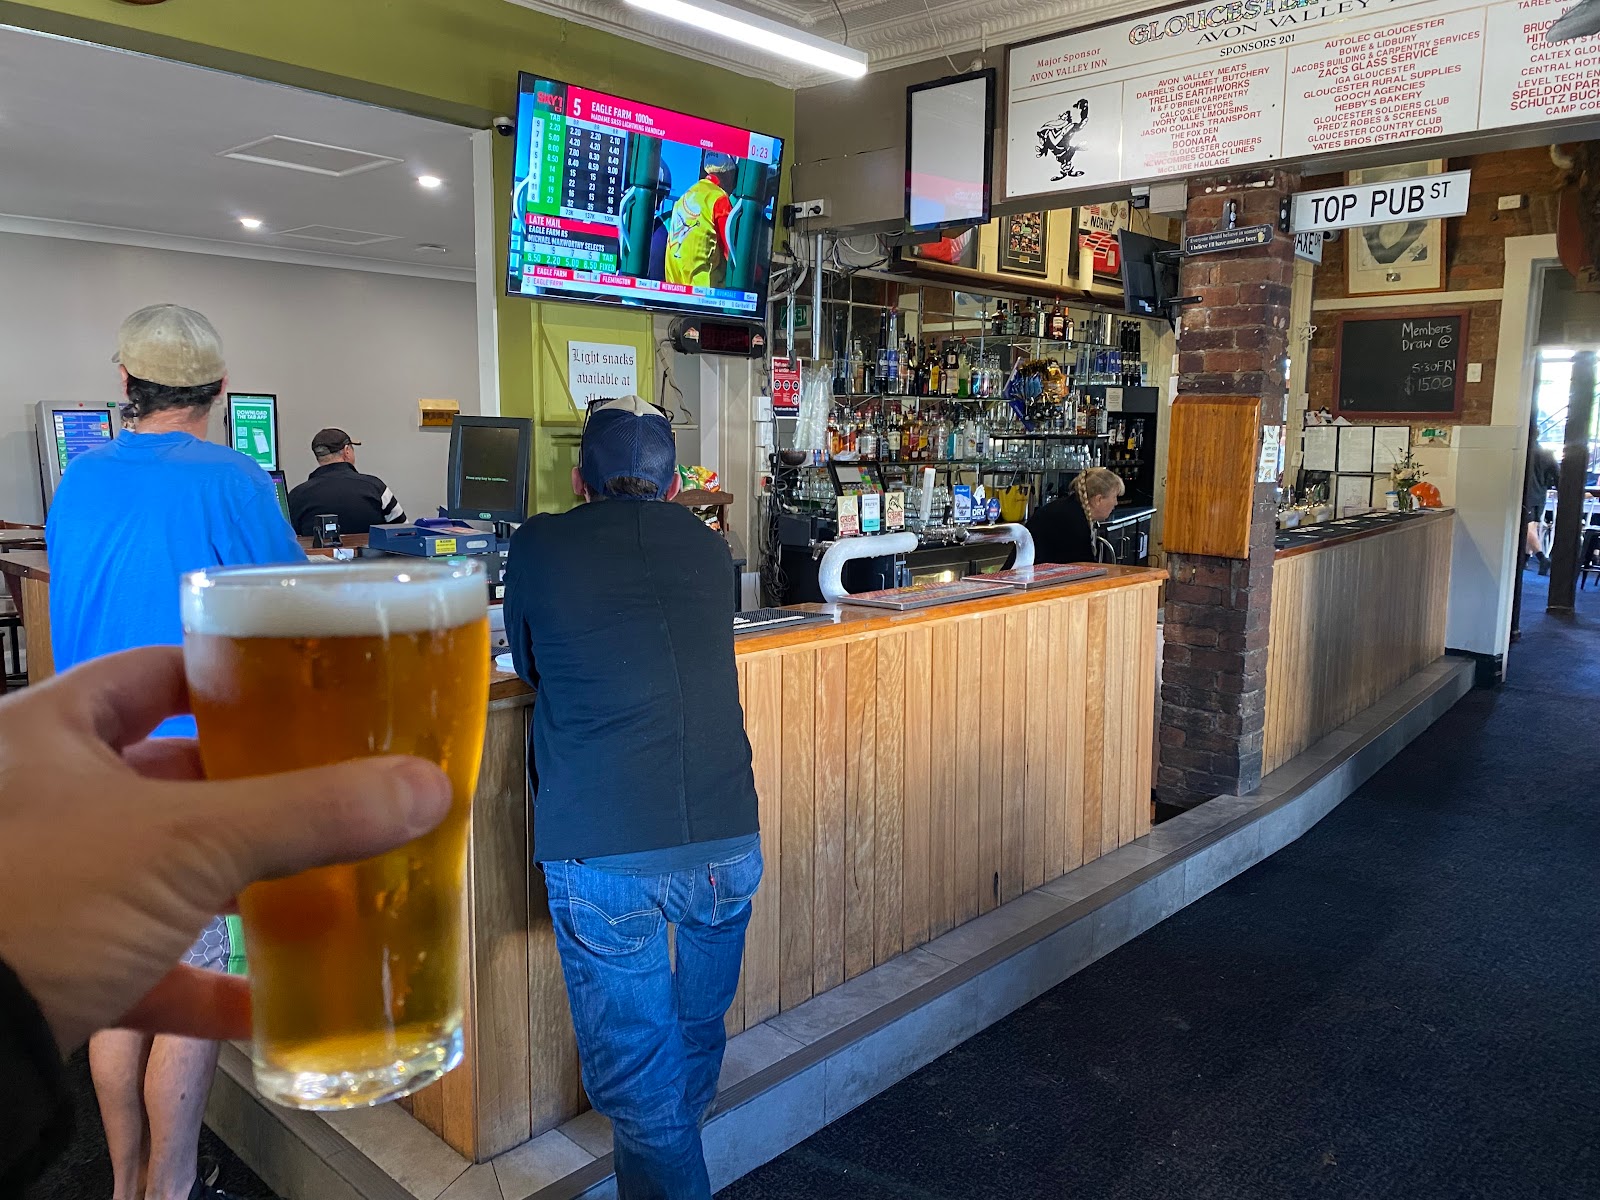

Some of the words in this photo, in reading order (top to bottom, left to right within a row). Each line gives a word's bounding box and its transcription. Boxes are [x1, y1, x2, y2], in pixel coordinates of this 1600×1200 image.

[1196, 21, 1258, 45] AVON
[1268, 0, 1370, 28] VALLEY
[1324, 33, 1370, 49] AUTOLEC
[1373, 18, 1445, 38] GLOUCESTER
[1220, 40, 1276, 57] SPONSORS
[1279, 34, 1295, 44] 201
[1291, 61, 1325, 74] JACOBS
[1327, 53, 1366, 67] BUILDING
[1376, 40, 1431, 57] CARPENTRY
[1433, 30, 1480, 46] SERVICES
[1339, 44, 1366, 56] BOWE
[1377, 34, 1418, 48] LIDBURY
[1037, 55, 1061, 68] Major
[1063, 48, 1101, 62] Sponsor
[1318, 65, 1348, 78] ZAC'S
[1351, 56, 1388, 72] GLASS
[1391, 46, 1439, 64] SERVICE
[1530, 49, 1571, 63] CALTEX
[1030, 70, 1054, 82] AVON
[1056, 63, 1089, 77] VALLEY
[1090, 58, 1108, 68] INN
[1158, 77, 1180, 87] AVON
[1183, 70, 1215, 82] VALLEY
[1217, 63, 1247, 75] MEATS
[1335, 76, 1350, 84] IGA
[1353, 63, 1416, 82] GLOUCESTER
[1521, 61, 1571, 76] CENTRAL
[1136, 86, 1175, 100] DARREL'S
[1177, 77, 1219, 91] GOURMET
[1222, 67, 1270, 82] BUTCHERY
[1303, 81, 1369, 99] GLOUCESTER
[1371, 75, 1407, 88] RURAL
[1410, 64, 1462, 80] SUPPLIES
[1517, 77, 1551, 89] LEVEL
[1555, 71, 1583, 82] TECH
[1149, 92, 1183, 106] TRELLIS
[1185, 79, 1250, 99] EARTHWORKS
[1170, 99, 1200, 109] O'BRIEN
[1201, 89, 1249, 104] CARPENTRY
[1333, 90, 1370, 103] GOOCH
[1373, 80, 1426, 96] AGENCIES
[1335, 98, 1377, 112] HEBBY'S
[1379, 90, 1423, 104] BAKERY
[1512, 82, 1571, 100] SPELDON
[573, 97, 582, 116] 5
[591, 101, 612, 116] EAGLE
[613, 106, 632, 120] FARM
[634, 113, 654, 126] 1000m
[1160, 109, 1185, 119] CALCO
[1187, 100, 1234, 114] SURVEYORS
[1313, 109, 1373, 125] GLOUCESTER
[1375, 101, 1422, 115] SOLDIERS
[1424, 96, 1450, 107] CLUB
[1510, 94, 1566, 111] SCHULTZ
[1545, 104, 1577, 115] CAMP
[550, 113, 561, 121] TAB
[590, 113, 610, 123] MADAME
[645, 125, 666, 137] HANDICAP
[1140, 126, 1168, 137] JASON
[1169, 120, 1205, 132] COLLINS
[1208, 110, 1262, 125] TRANSPORT
[1152, 117, 1177, 127] IVORY
[1180, 114, 1200, 123] VALE
[1202, 104, 1249, 119] LIMOUSINS
[1317, 120, 1348, 132] PRED'Z
[1350, 116, 1381, 127] ROBES
[1392, 107, 1437, 120] SCREENS
[549, 123, 560, 131] 2.20
[570, 127, 581, 136] 2.20
[590, 131, 601, 140] 2.20
[609, 136, 620, 145] 2.10
[1171, 132, 1185, 140] THE
[1187, 129, 1201, 138] FOX
[1203, 126, 1219, 135] DEN
[1307, 127, 1367, 143] GLOUCESTER
[1369, 120, 1414, 134] COUNTRY
[1417, 116, 1442, 126] CLUB
[1312, 140, 1341, 151] YATES
[1343, 136, 1372, 147] BROS
[1374, 125, 1444, 144] (STRATFORD)
[569, 137, 580, 146] 4.20
[590, 142, 600, 150] 4.20
[751, 145, 769, 159] 0:23
[1170, 143, 1220, 156] GLOUCESTER
[1221, 136, 1262, 148] COURIERS
[1172, 135, 1217, 149] BOONARA
[1144, 154, 1196, 167] NEWCOMBES
[1198, 149, 1228, 159] COACH
[1230, 144, 1255, 155] LINES
[1158, 163, 1192, 174] McCLURE
[1193, 157, 1230, 168] HAULAGE
[1311, 194, 1357, 224] TOP
[1370, 185, 1425, 218] PUB
[1430, 181, 1451, 199] ST
[528, 225, 545, 235] EAGLE
[545, 228, 561, 237] FARM
[529, 214, 545, 225] LATE
[545, 218, 561, 229] MAIL
[528, 233, 551, 244] MICHAEL
[584, 242, 605, 252] SELECTS
[1226, 237, 1245, 245] another
[527, 253, 541, 263] 8.50
[546, 256, 561, 265] 2.20
[565, 258, 579, 268] 5.00
[583, 261, 597, 270] 8.50
[599, 262, 616, 272] FIXED
[602, 254, 614, 262] TAB
[537, 267, 553, 276] EAGLE
[553, 269, 568, 277] FARM
[602, 276, 631, 285] FLEMINGTON
[661, 281, 687, 293] NEWCASTLE
[1401, 321, 1453, 338] Members
[1402, 338, 1433, 351] Draw
[1437, 335, 1452, 348] @
[571, 348, 599, 366] Light
[602, 353, 634, 366] snacks
[577, 371, 619, 386] available
[621, 375, 630, 386] at
[972, 508, 986, 516] DRY
